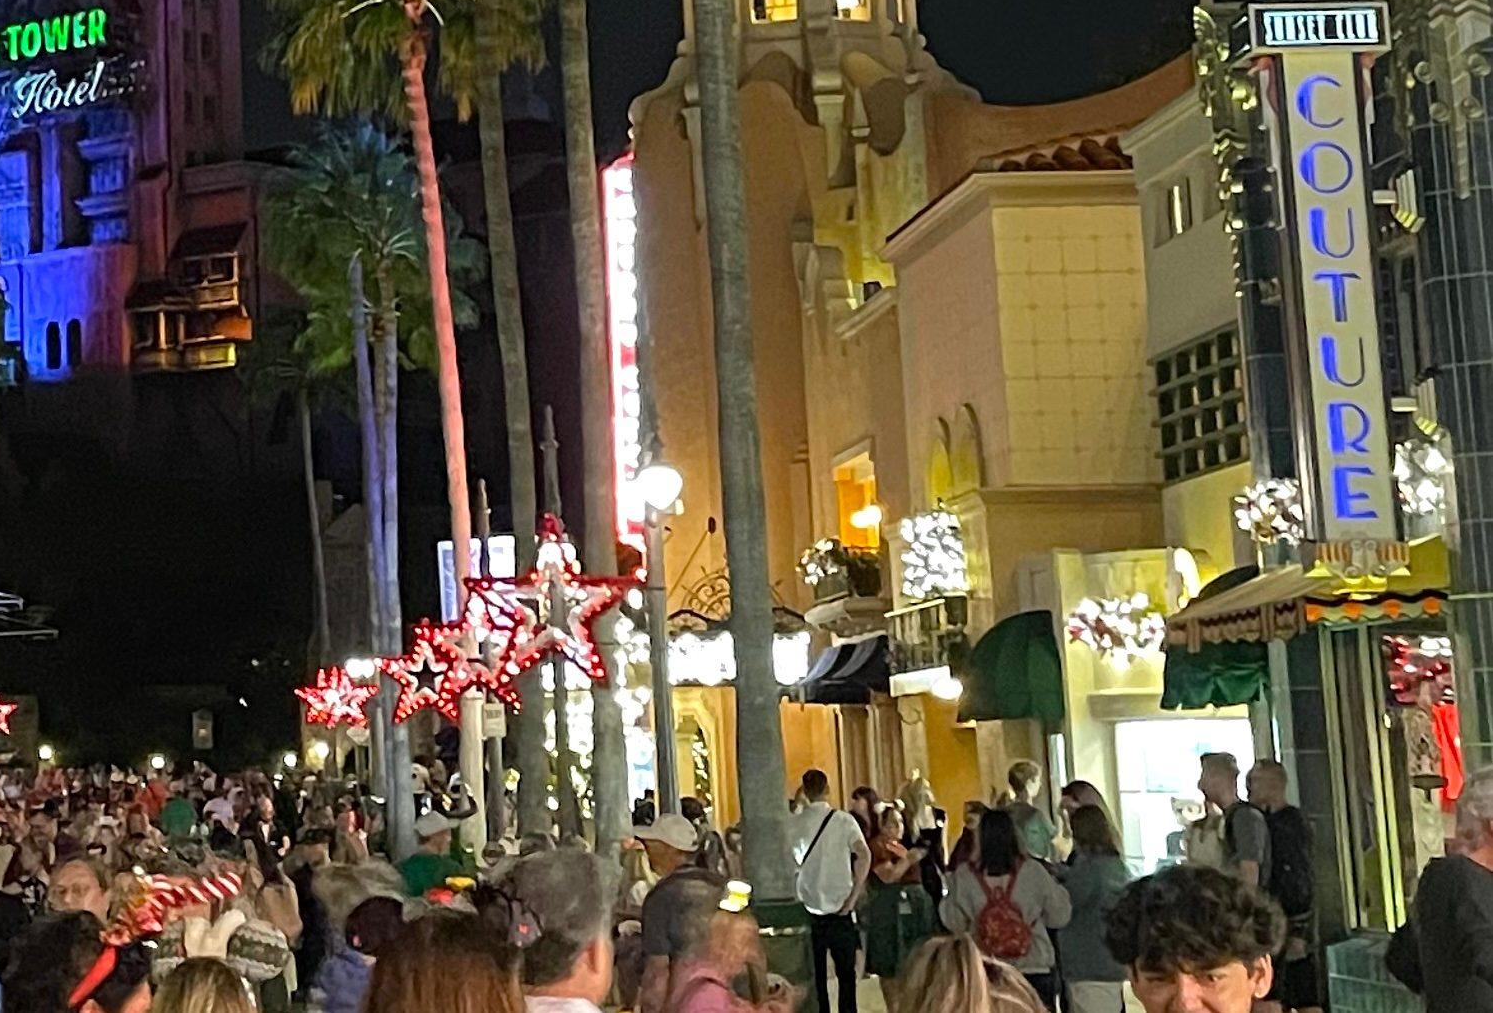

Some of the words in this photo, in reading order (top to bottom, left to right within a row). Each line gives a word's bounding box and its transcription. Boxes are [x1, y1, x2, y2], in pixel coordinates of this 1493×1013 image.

[7, 8, 107, 61] TOWER
[1264, 12, 1327, 44] SUNSET
[10, 59, 106, 119] Hotel
[1296, 75, 1378, 520] COUTURE
